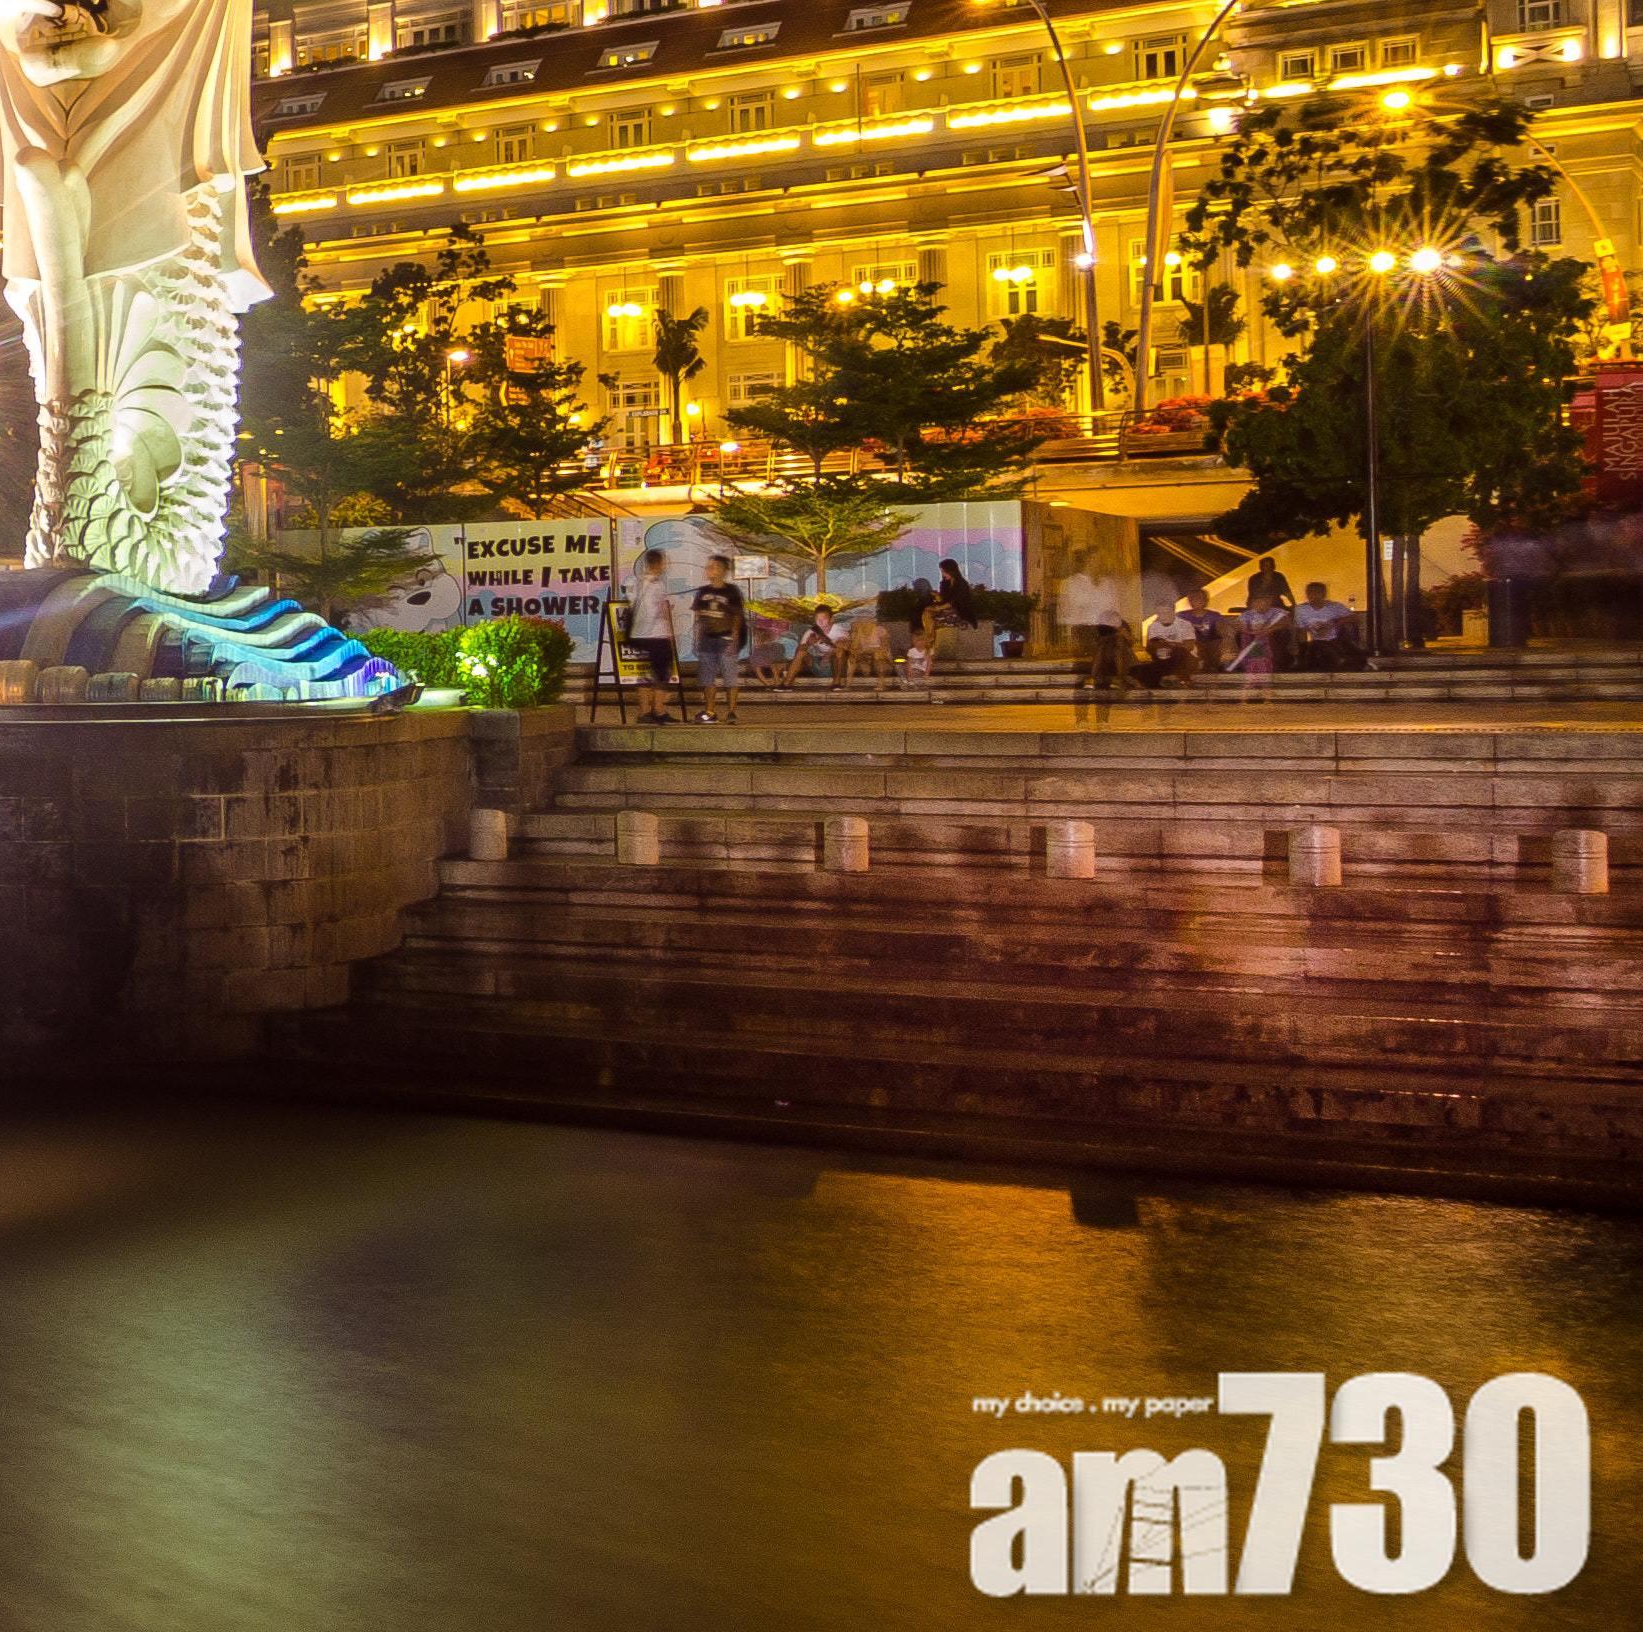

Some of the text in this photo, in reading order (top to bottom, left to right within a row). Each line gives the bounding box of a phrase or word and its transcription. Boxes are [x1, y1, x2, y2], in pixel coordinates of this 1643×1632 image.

[1602, 388, 1622, 472] MAJULAH
[1619, 382, 1637, 481] SINGAPURA
[565, 534, 602, 554] ME
[467, 565, 611, 587] WHILE I TAKE
[468, 595, 600, 617] A SHOWER
